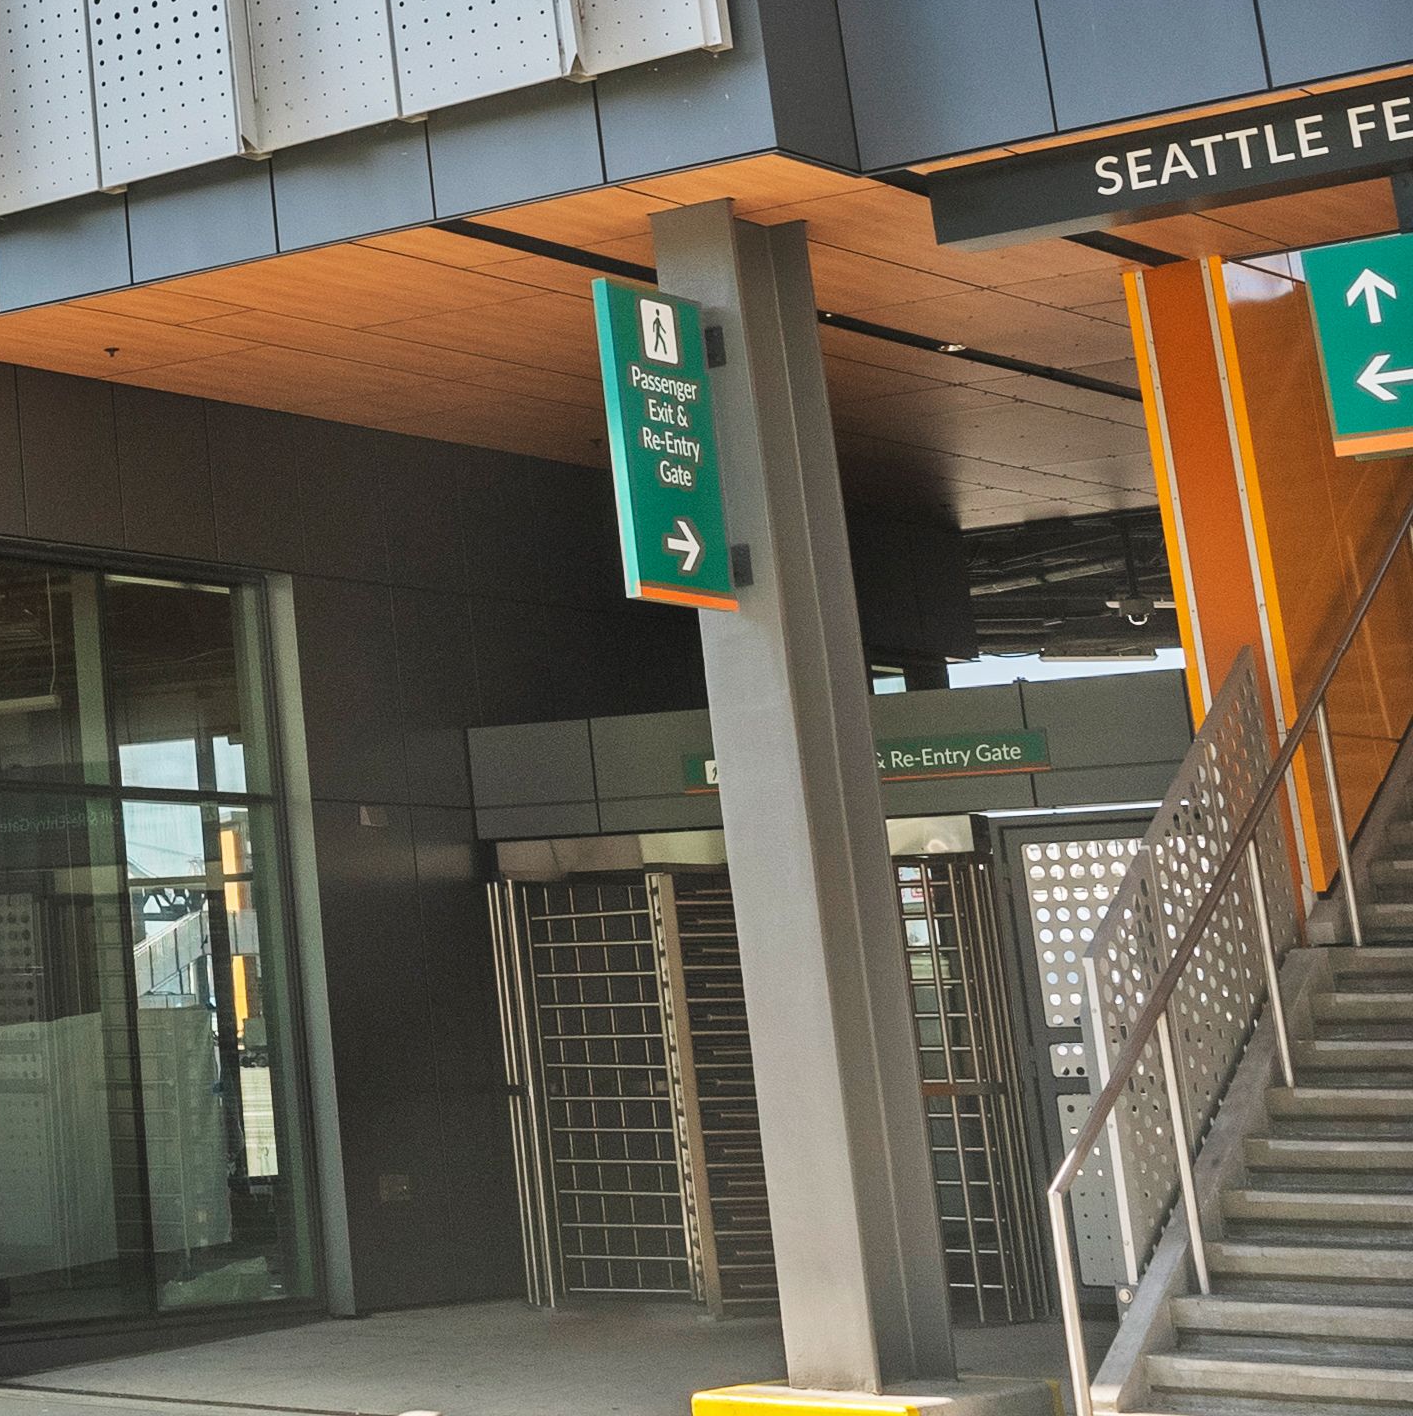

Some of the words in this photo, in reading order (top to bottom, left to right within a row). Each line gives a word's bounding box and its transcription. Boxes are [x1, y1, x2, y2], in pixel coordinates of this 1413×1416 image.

[1095, 115, 1330, 196] SEATTLE
[1347, 97, 1413, 149] FE
[631, 365, 698, 401] Passenger
[648, 399, 675, 426] Exit
[677, 406, 689, 428] &
[642, 426, 701, 463] Re-Entry
[659, 460, 693, 487] Gate
[890, 747, 972, 768] Re-Entry
[975, 743, 1022, 763] Gate
